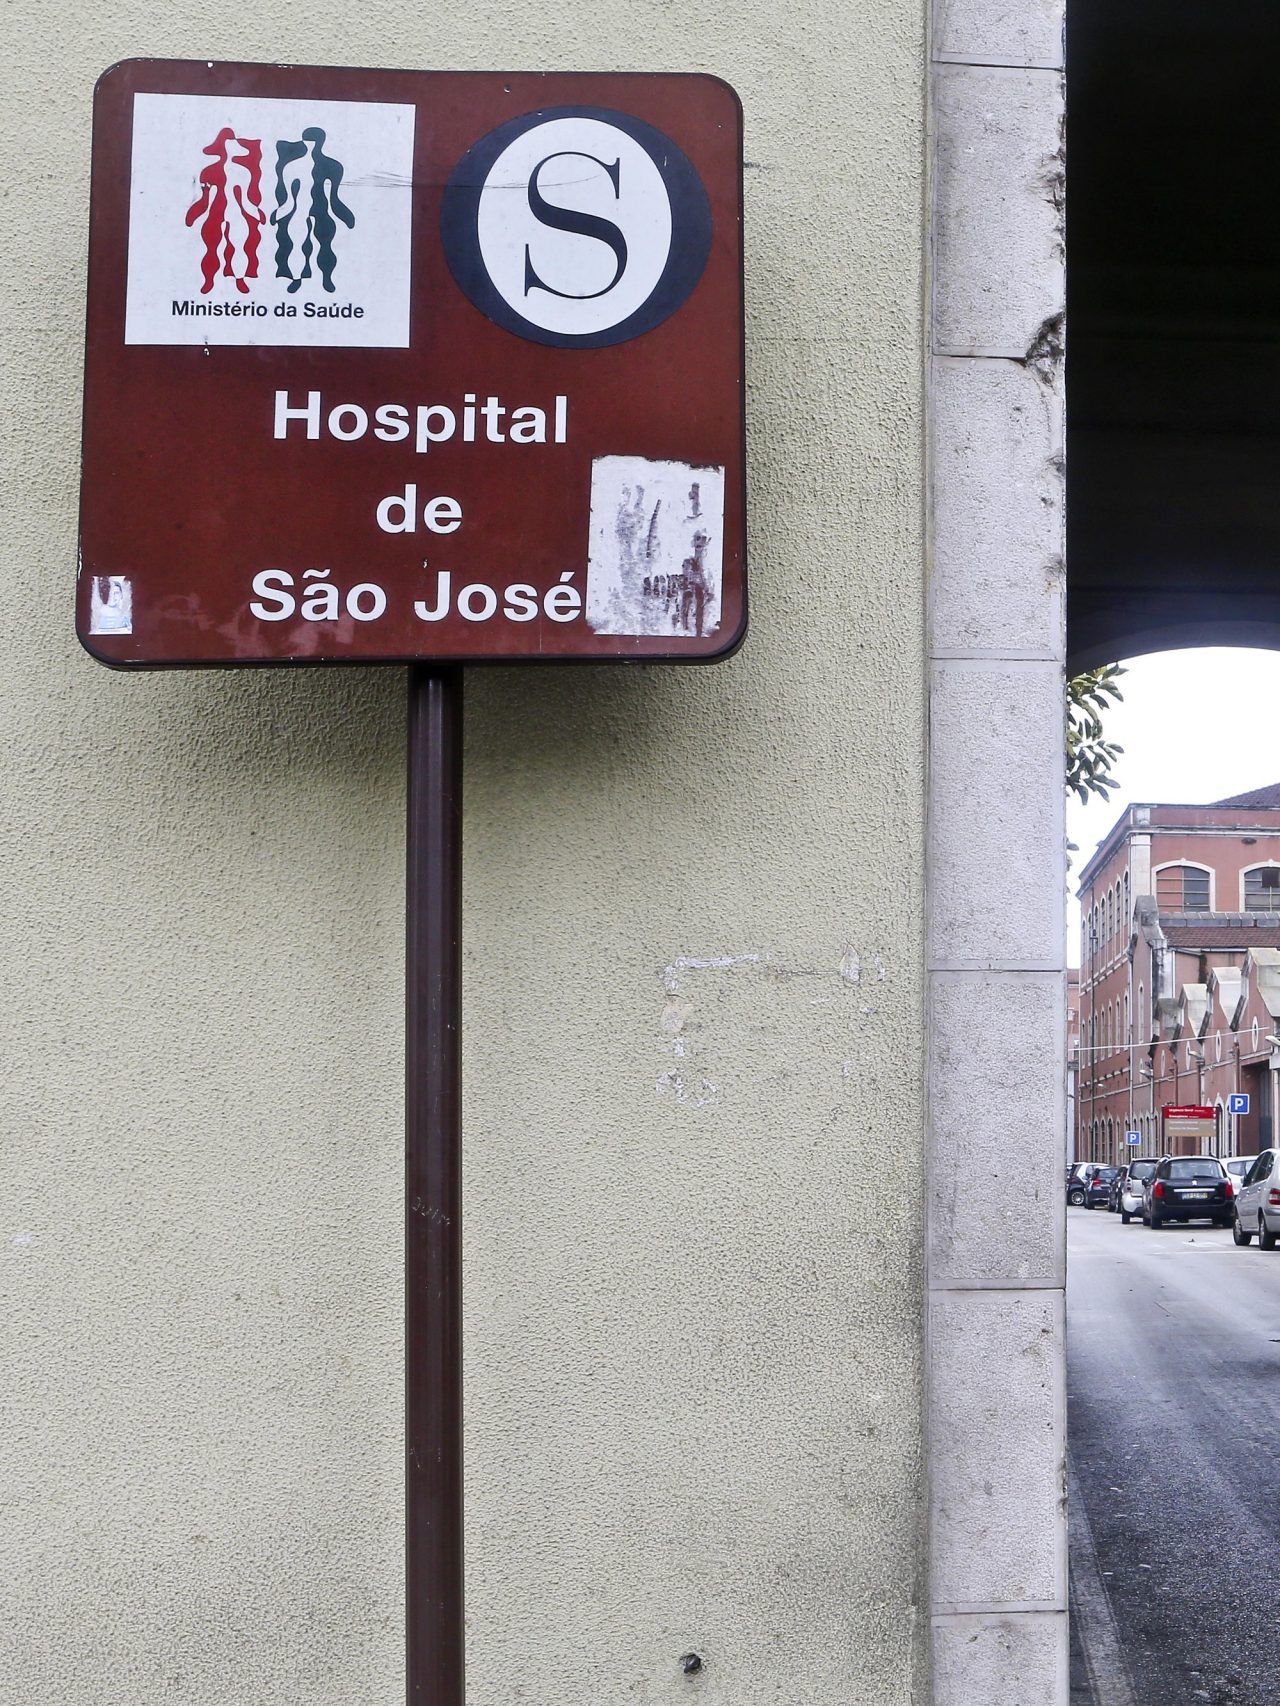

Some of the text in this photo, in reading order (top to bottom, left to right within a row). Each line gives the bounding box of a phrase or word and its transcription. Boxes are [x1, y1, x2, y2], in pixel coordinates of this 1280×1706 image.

[524, 151, 628, 300] S
[171, 301, 365, 319] Ministério da Saúde
[273, 390, 567, 454] Hospital
[376, 483, 463, 534] de
[249, 568, 582, 623] São José
[1234, 1097, 1244, 1111] P
